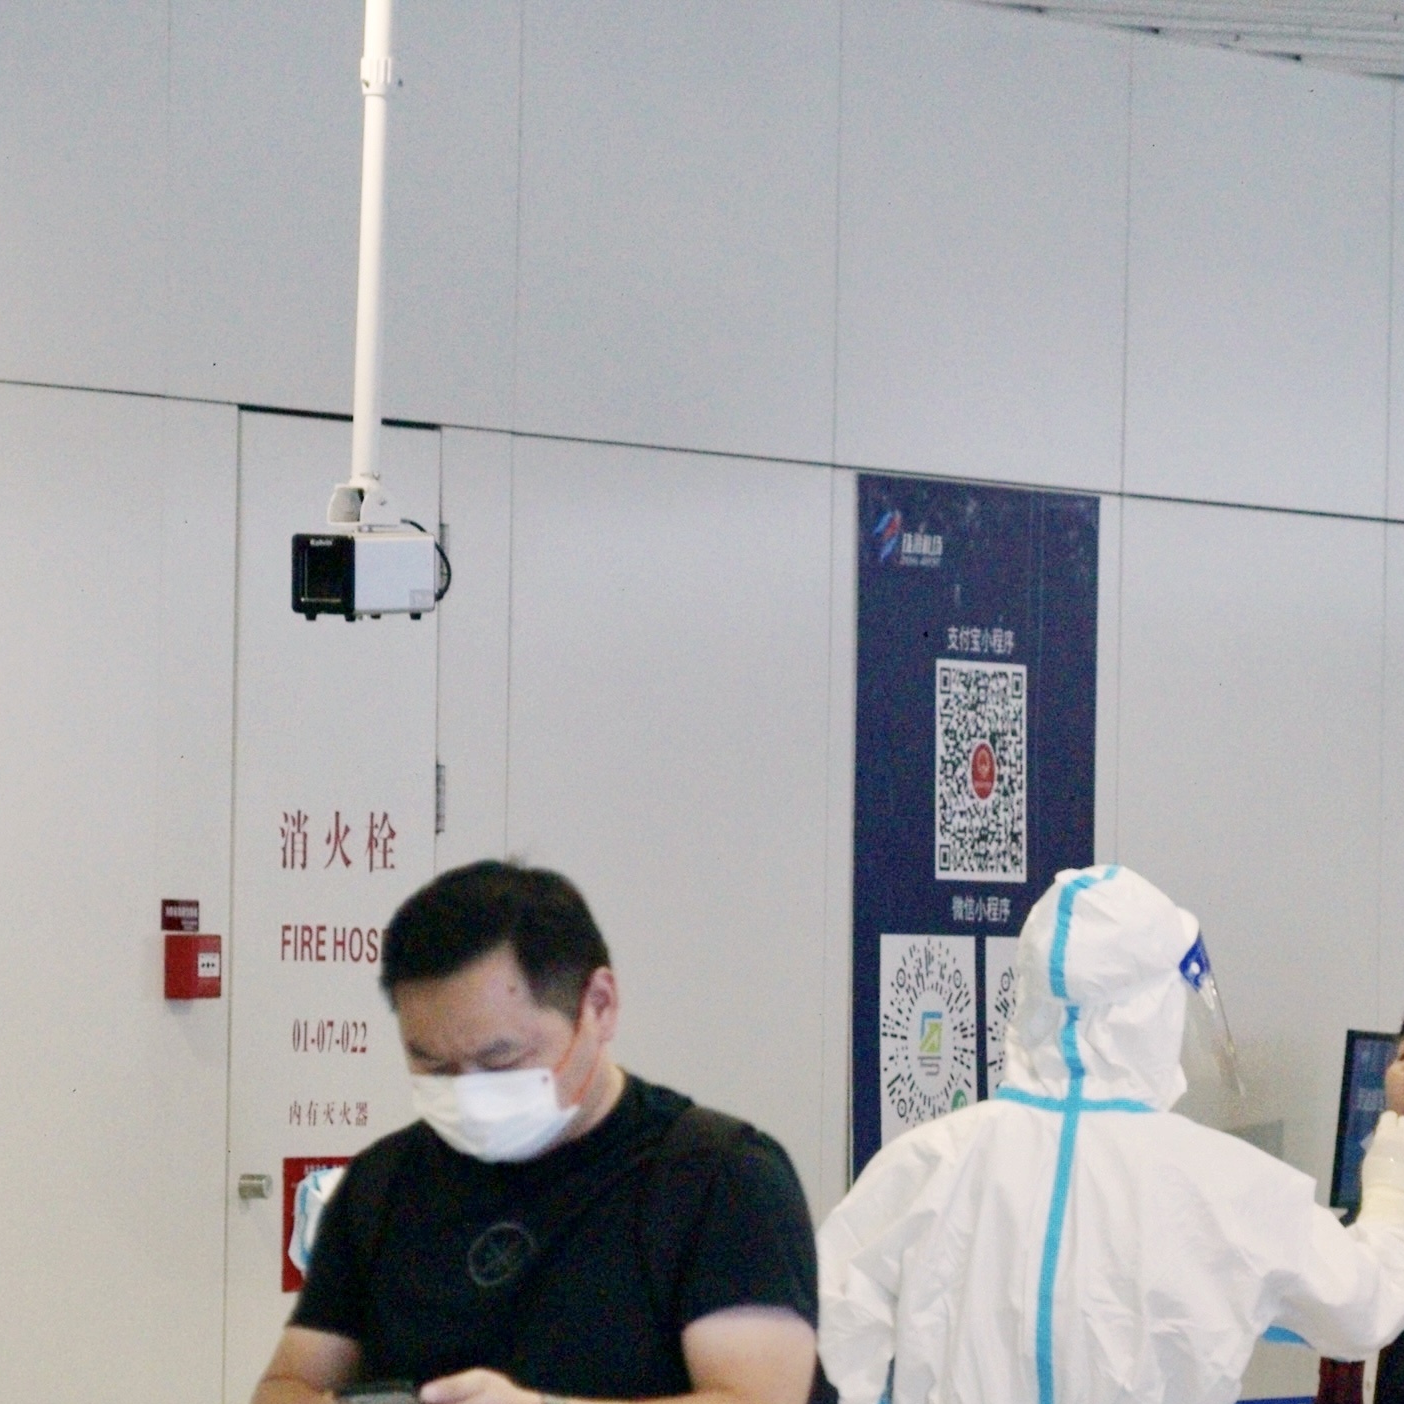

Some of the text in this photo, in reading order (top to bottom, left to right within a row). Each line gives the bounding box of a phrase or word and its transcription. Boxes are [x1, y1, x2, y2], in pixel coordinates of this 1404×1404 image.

[947, 626, 1014, 654] 支付宝小程序
[280, 810, 396, 872] 消火栓
[952, 895, 1011, 922] 微信小程序
[282, 925, 326, 961] FIRE
[289, 1100, 367, 1126] 内有灭火器
